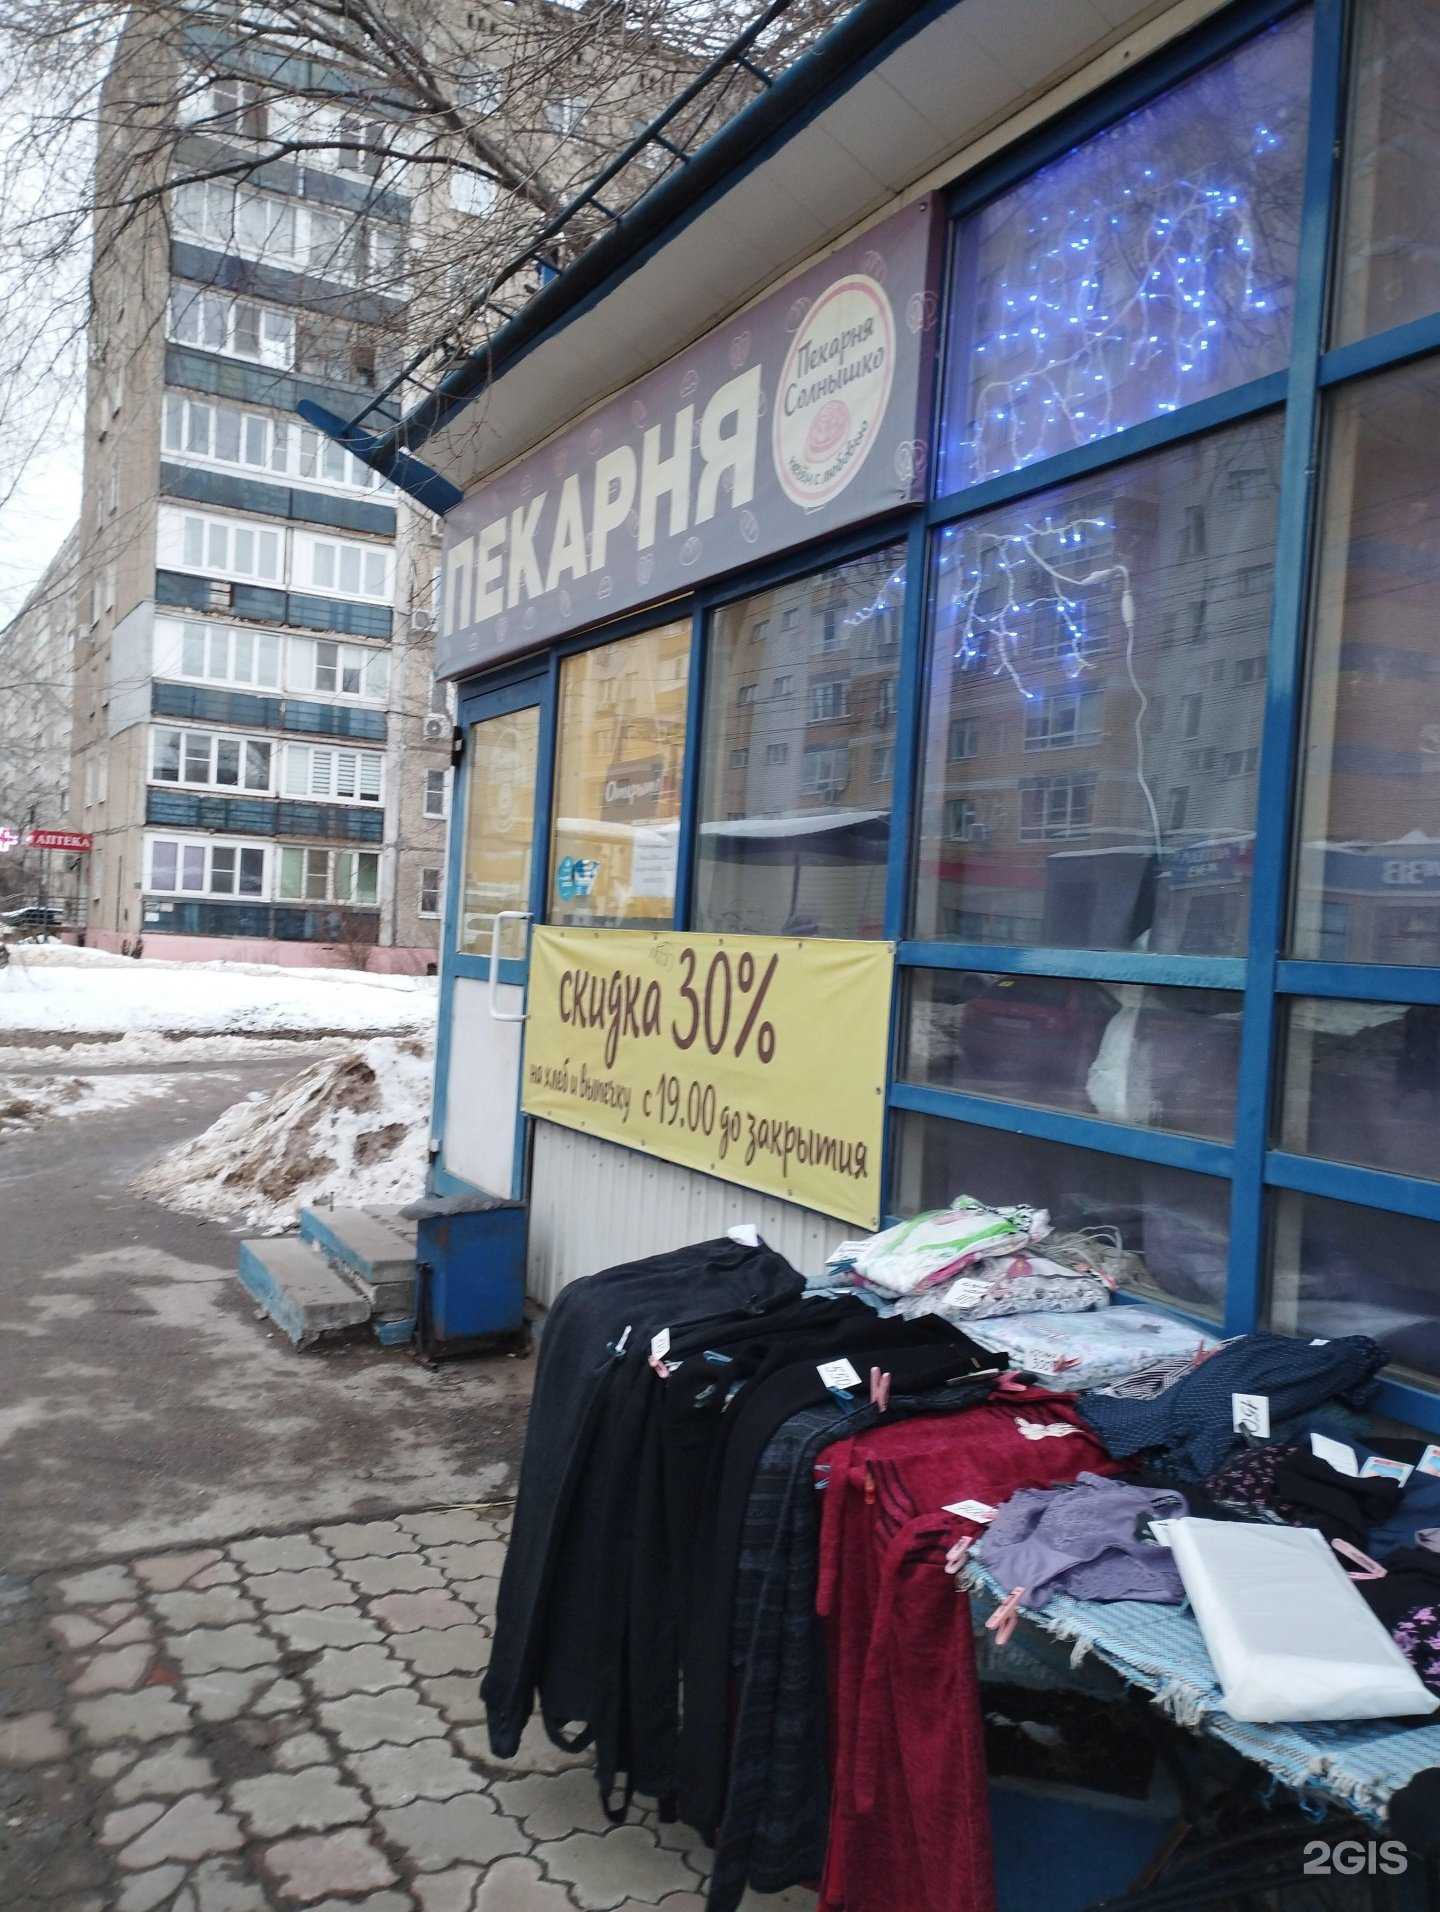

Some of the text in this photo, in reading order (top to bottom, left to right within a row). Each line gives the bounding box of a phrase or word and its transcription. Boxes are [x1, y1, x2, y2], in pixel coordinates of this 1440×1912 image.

[784, 347, 884, 417] Солнышко
[797, 316, 875, 379] Пекарня
[443, 363, 762, 637] ПЕКАРНЯ
[35, 834, 91, 848] АПТЕКА
[559, 947, 779, 1070] скидка 30%
[529, 1057, 868, 1179] на хлеб и выпечку с 19.00 до закрытия
